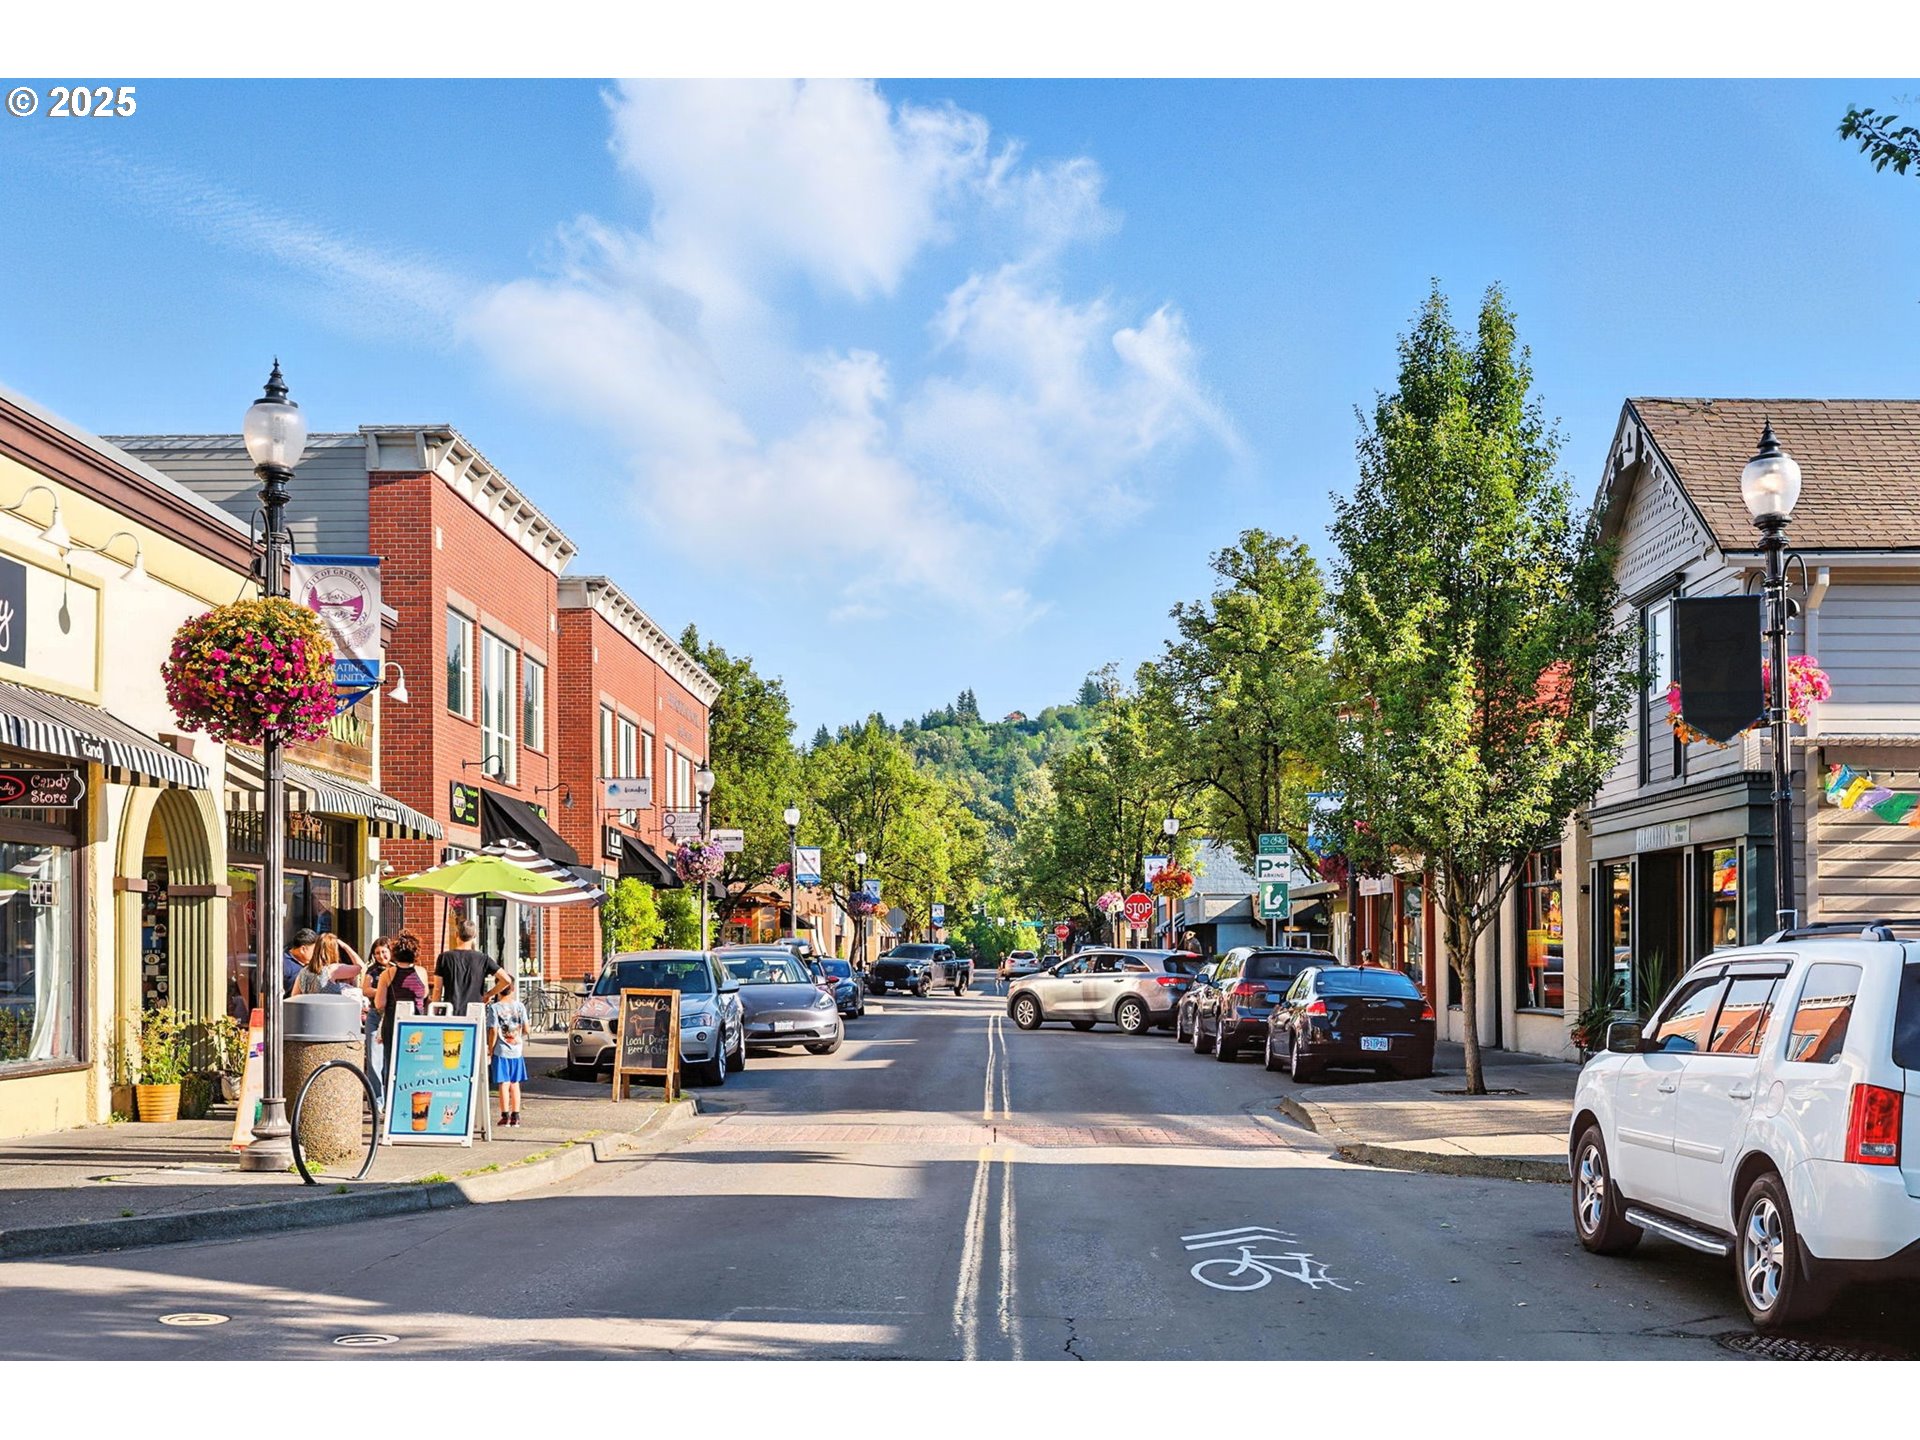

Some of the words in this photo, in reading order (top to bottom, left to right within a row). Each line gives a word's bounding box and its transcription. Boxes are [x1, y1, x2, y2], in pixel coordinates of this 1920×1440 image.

[306, 575, 320, 590] CITY
[321, 569, 331, 577] OF
[333, 569, 367, 592] GRESHAM
[81, 739, 105, 764] iCandy
[30, 773, 70, 791] Candy
[30, 790, 67, 804] Store
[1126, 902, 1152, 914] STOP
[629, 997, 656, 1011] Local
[626, 1033, 645, 1046] Local
[627, 1045, 643, 1055] Beer
[644, 1045, 650, 1054] &
